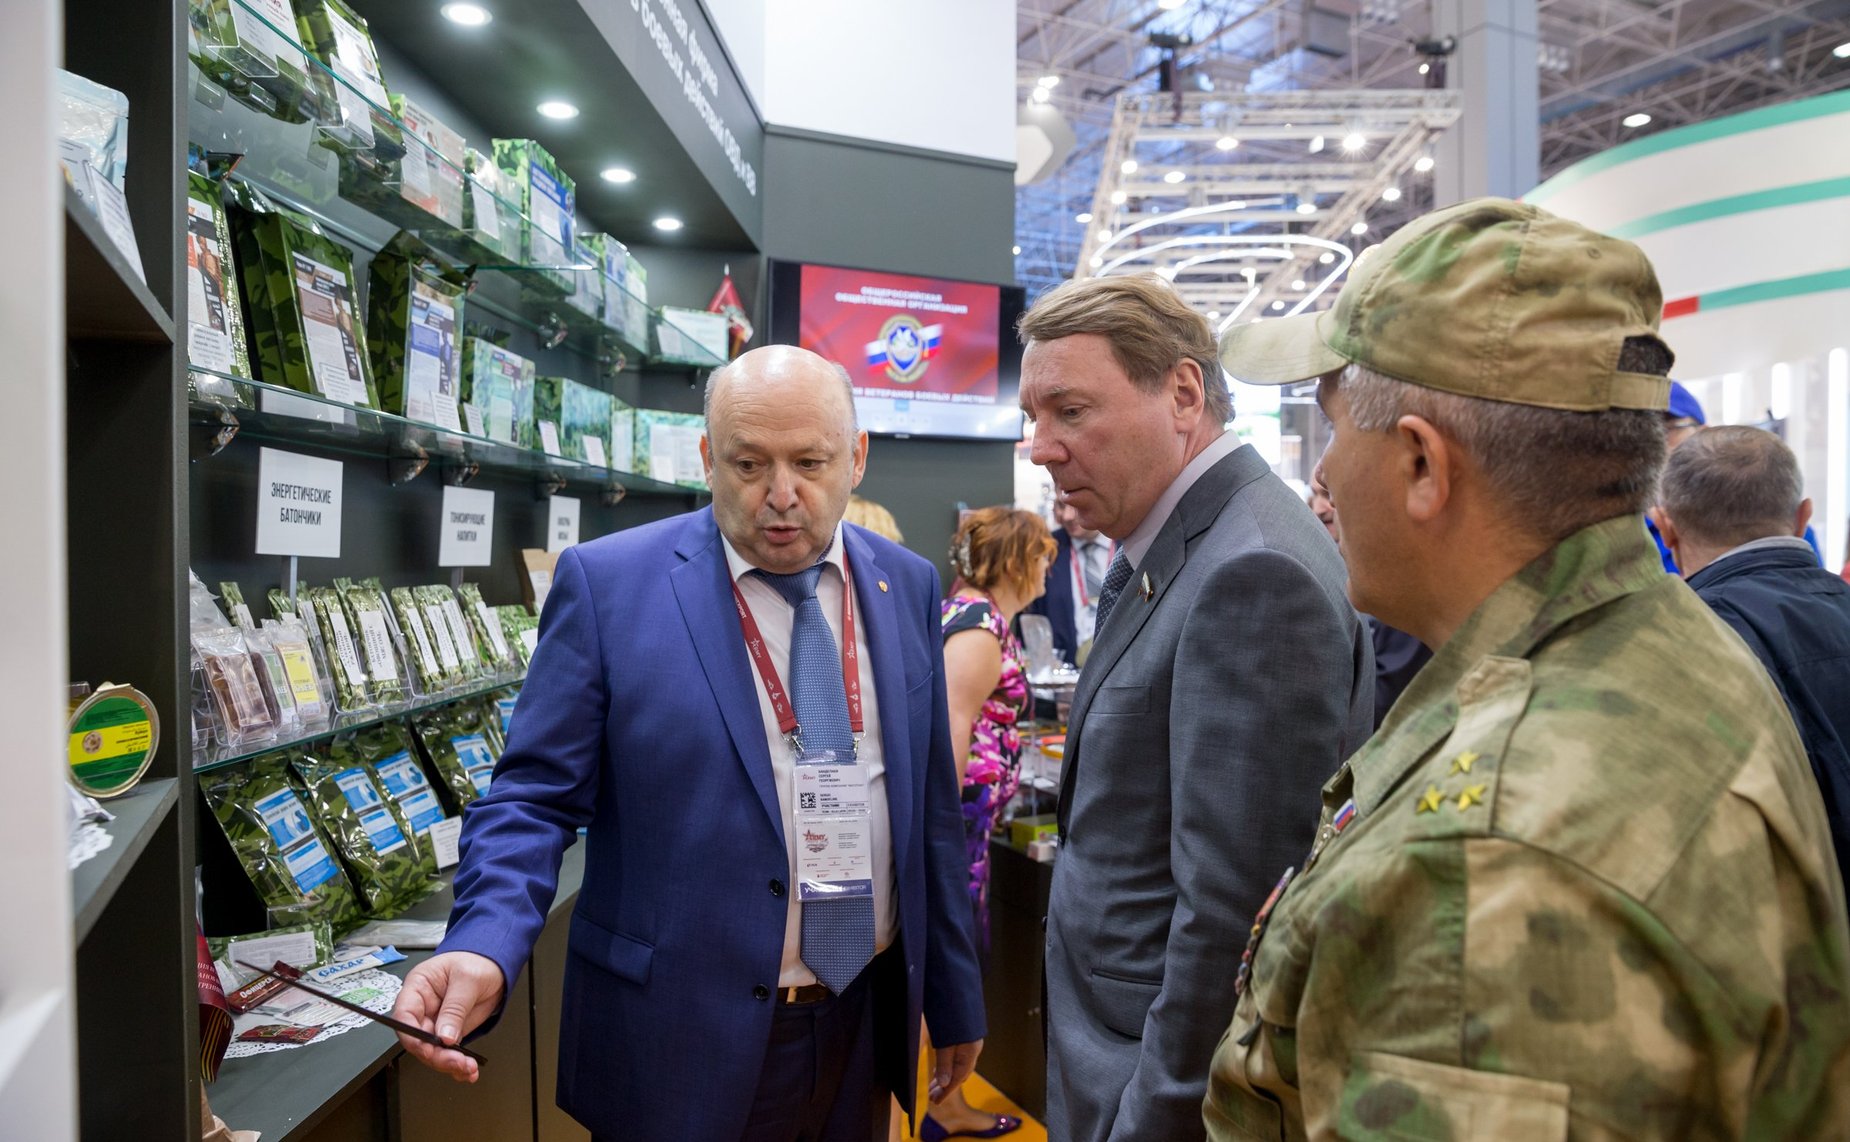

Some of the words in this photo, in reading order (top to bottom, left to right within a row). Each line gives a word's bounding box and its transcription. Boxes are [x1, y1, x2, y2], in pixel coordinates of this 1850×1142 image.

[271, 481, 332, 505] ЭНЕРГЕТИЧЕСКИЕ
[280, 507, 322, 525] БАТОНЧИКИ
[316, 958, 364, 978] САХАР
